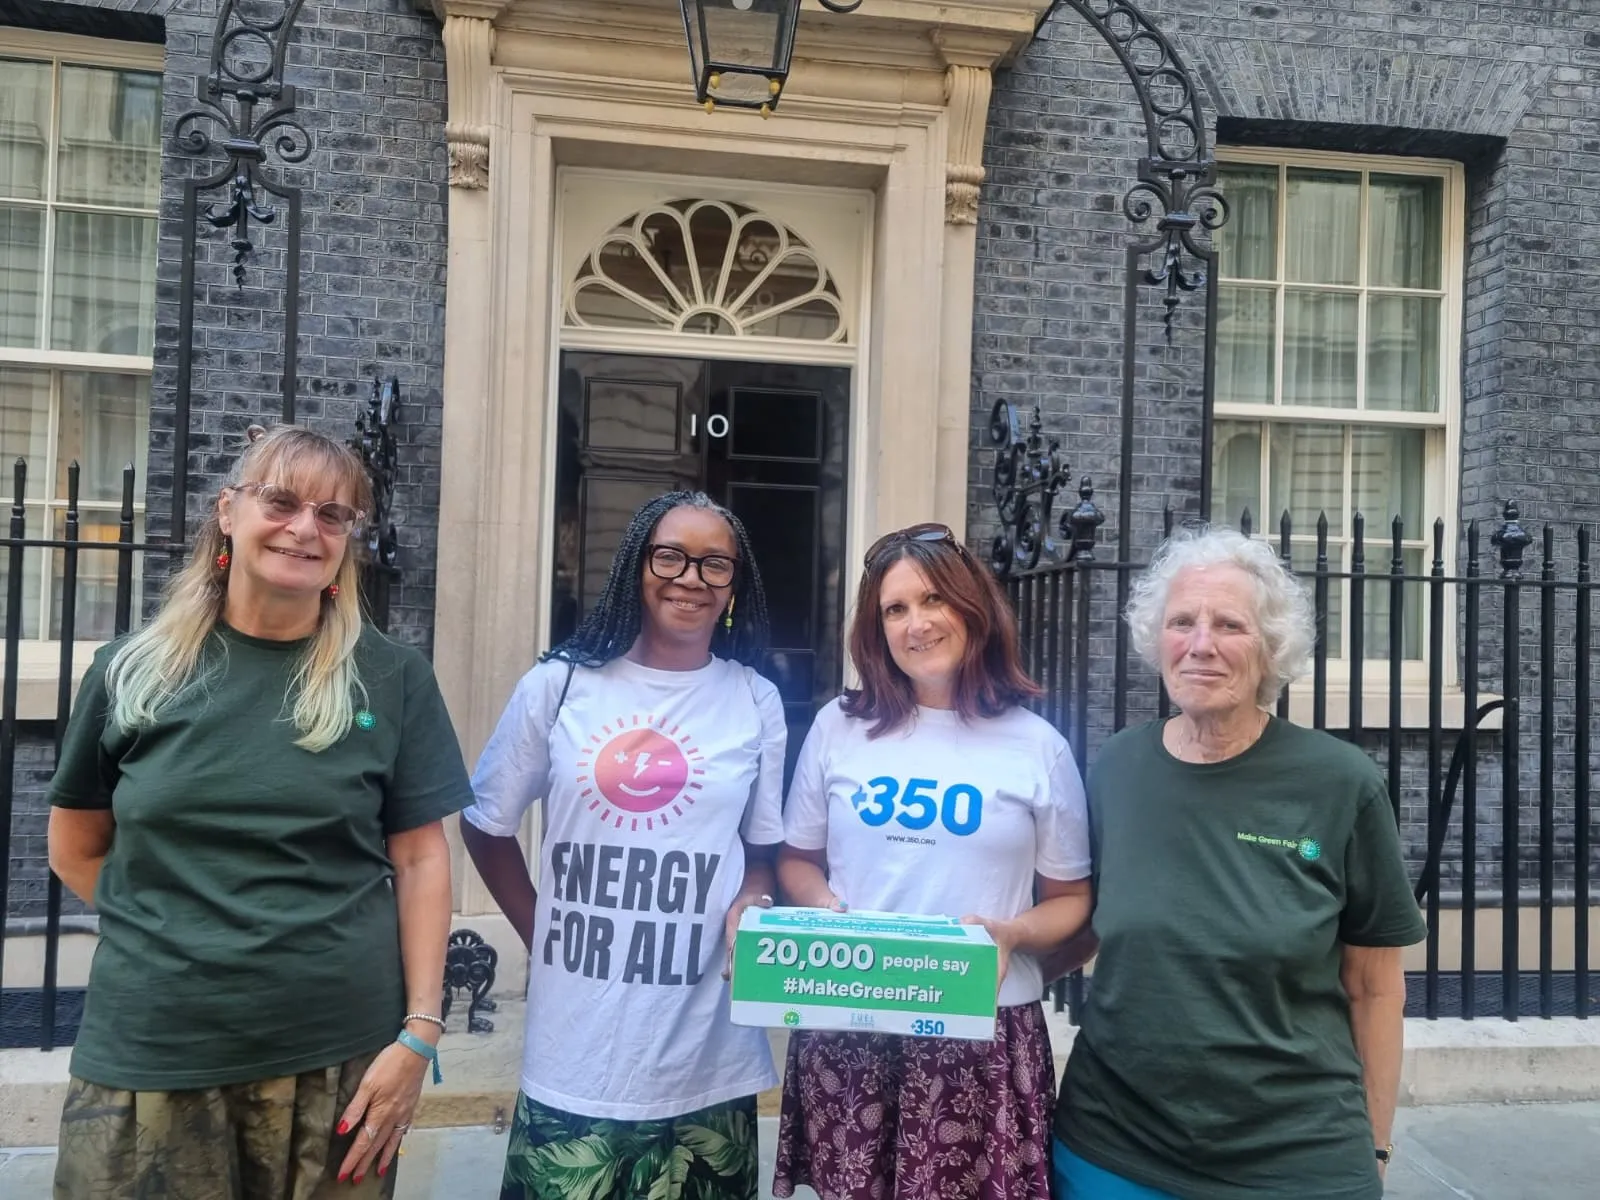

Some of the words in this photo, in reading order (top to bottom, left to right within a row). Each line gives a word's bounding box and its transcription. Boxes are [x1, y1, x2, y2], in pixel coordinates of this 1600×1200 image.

[691, 414, 729, 438] 10
[886, 834, 936, 846] WWW.350.ORG
[551, 841, 721, 915] ENERGY
[543, 906, 615, 981] FOR
[622, 920, 704, 986] ALL
[756, 937, 876, 972] 20,000
[882, 954, 939, 973] people
[942, 959, 970, 976] say
[783, 977, 944, 1004] #MakeGreenFair
